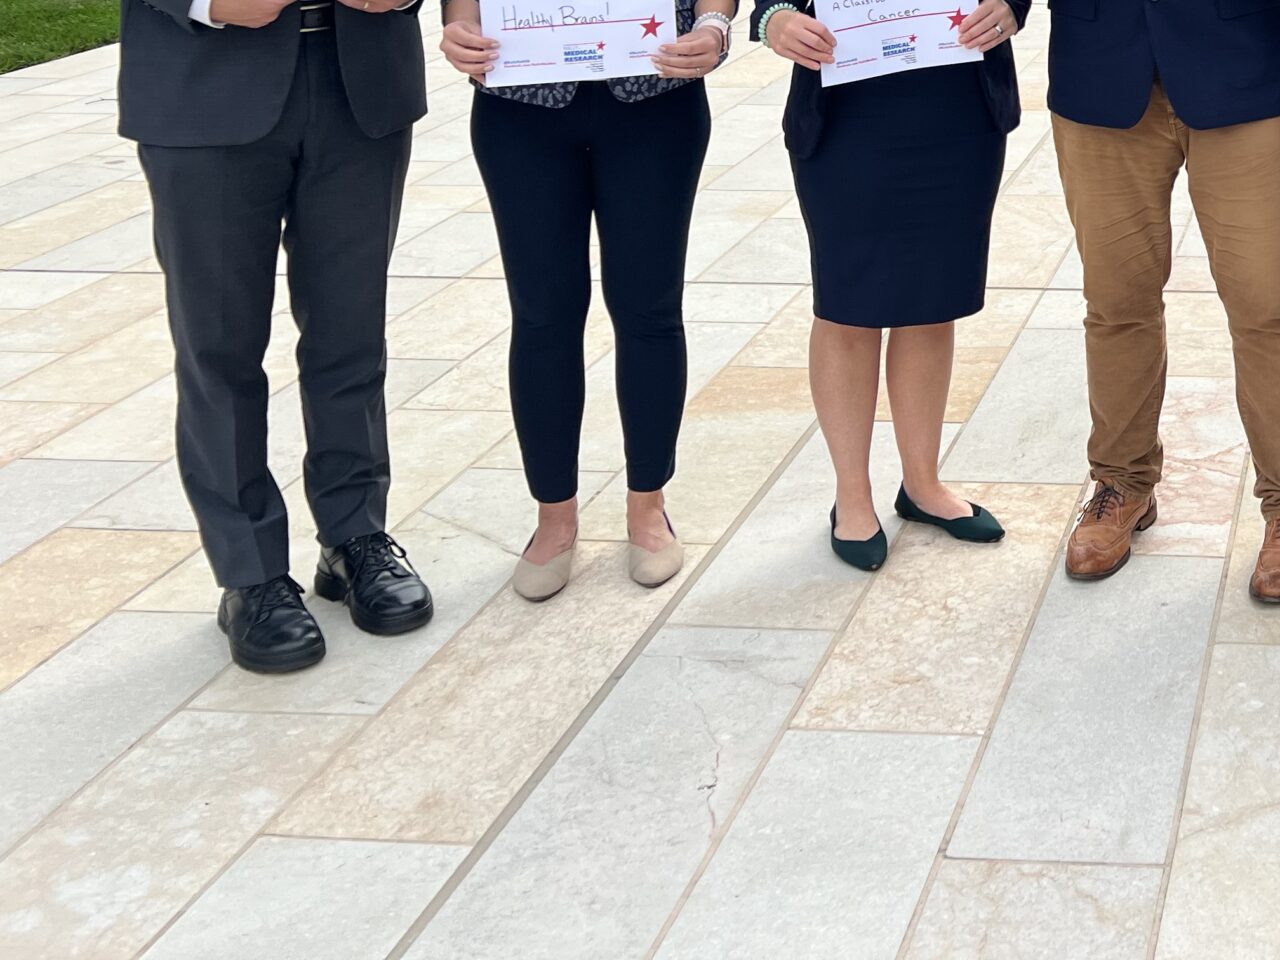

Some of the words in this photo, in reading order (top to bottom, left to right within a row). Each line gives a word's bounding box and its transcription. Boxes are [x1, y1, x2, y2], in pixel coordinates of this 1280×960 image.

[502, 5, 554, 32] Healthy
[868, 7, 920, 22] Cancer
[882, 42, 910, 52] MEDICAL
[882, 46, 916, 58] RESEARCH
[564, 49, 598, 57] MEDICAL
[564, 54, 604, 64] RESEARCH
